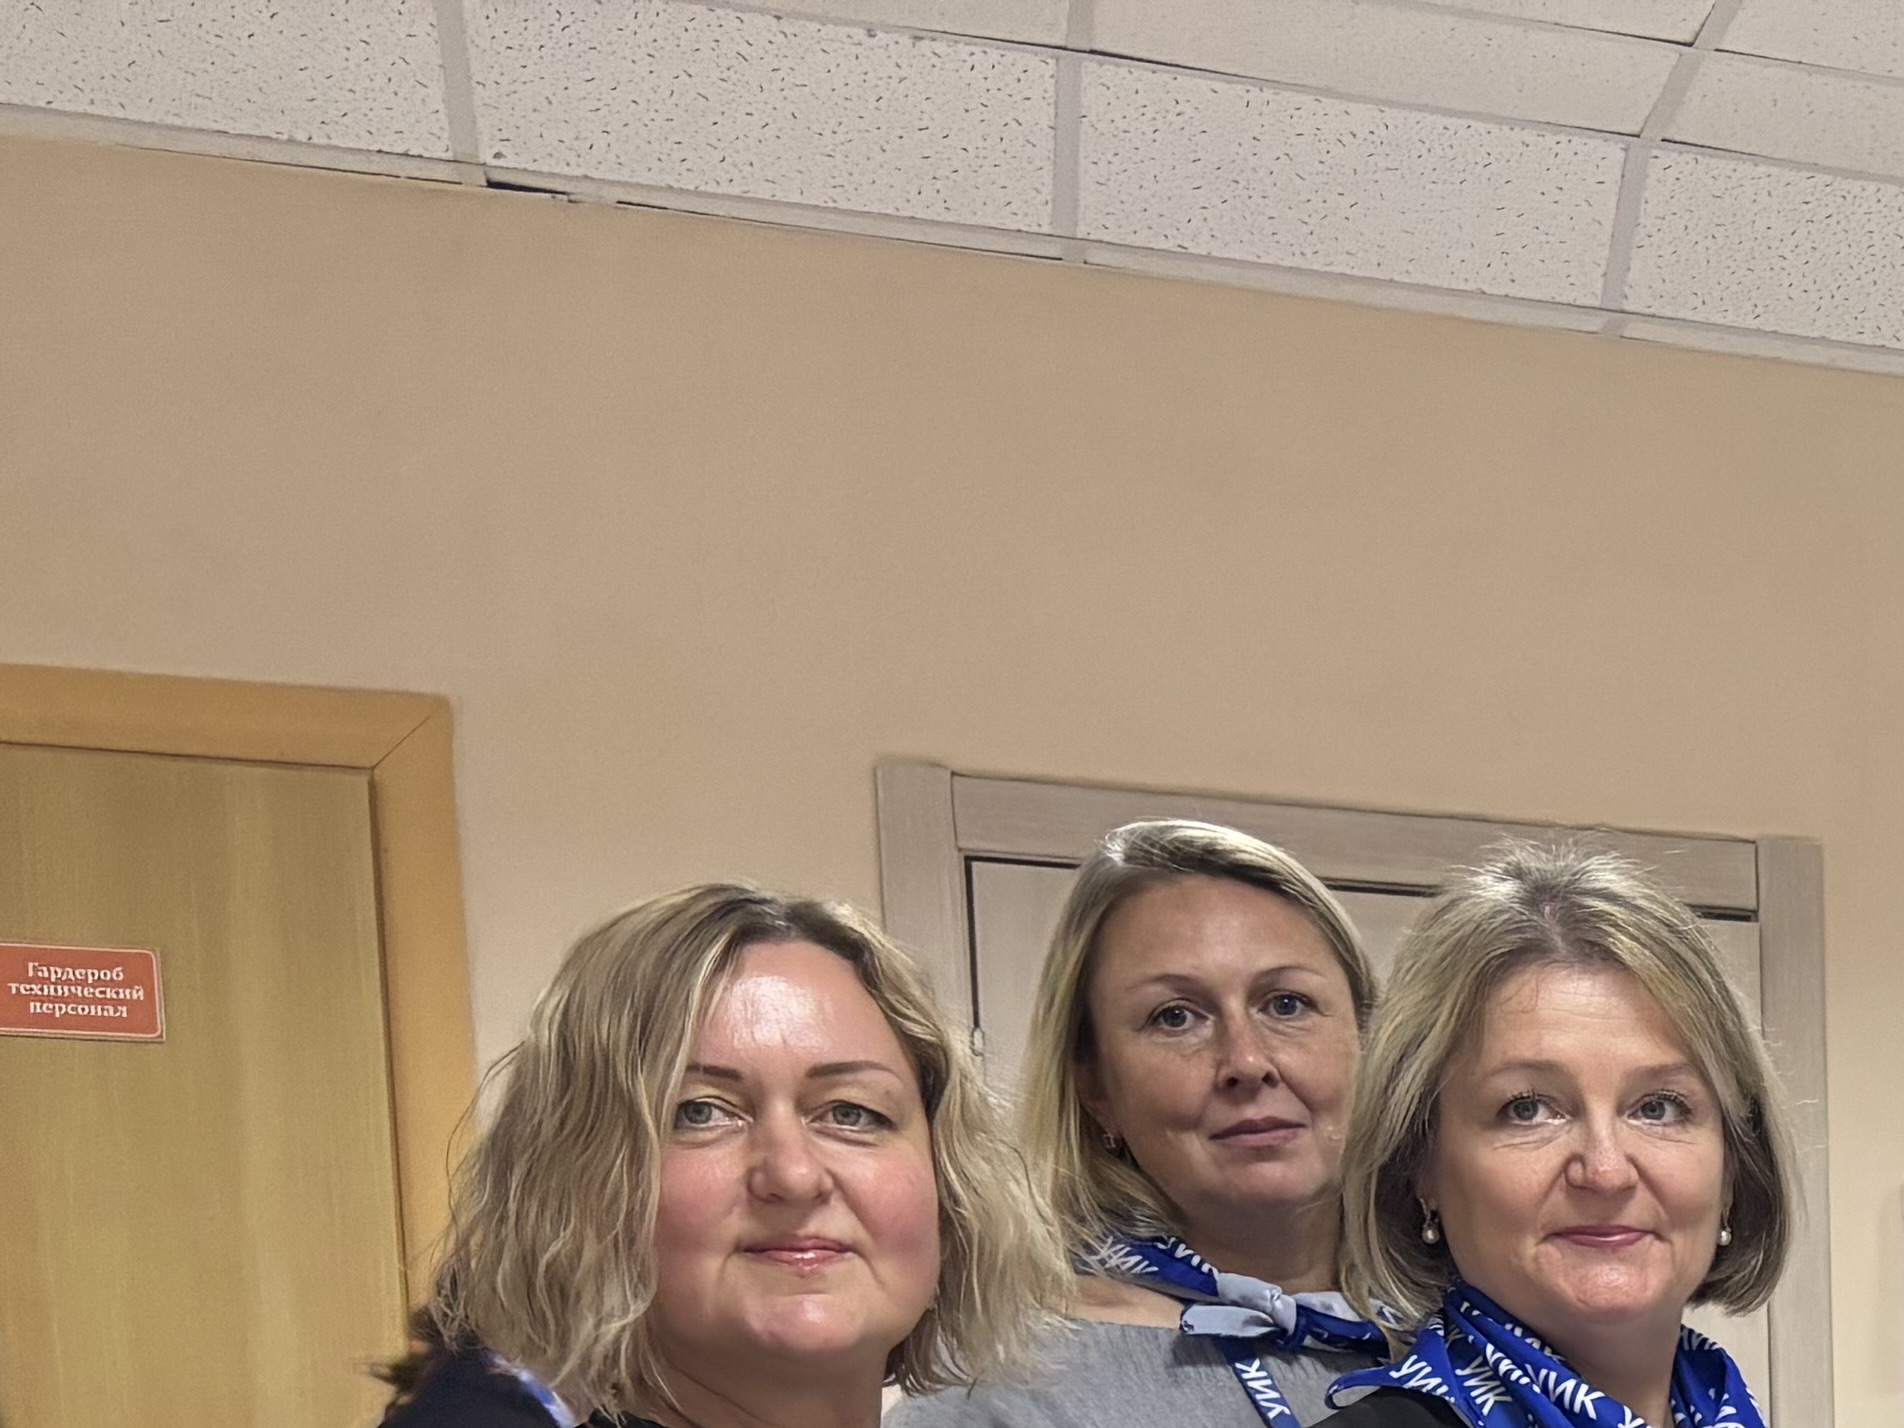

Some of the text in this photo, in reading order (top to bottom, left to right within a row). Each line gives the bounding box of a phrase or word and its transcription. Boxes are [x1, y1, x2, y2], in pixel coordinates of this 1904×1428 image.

[28, 961, 124, 984] Гардероб
[8, 982, 144, 1001] технический
[29, 1001, 128, 1018] персонал
[1235, 1358, 1291, 1420] УИК
